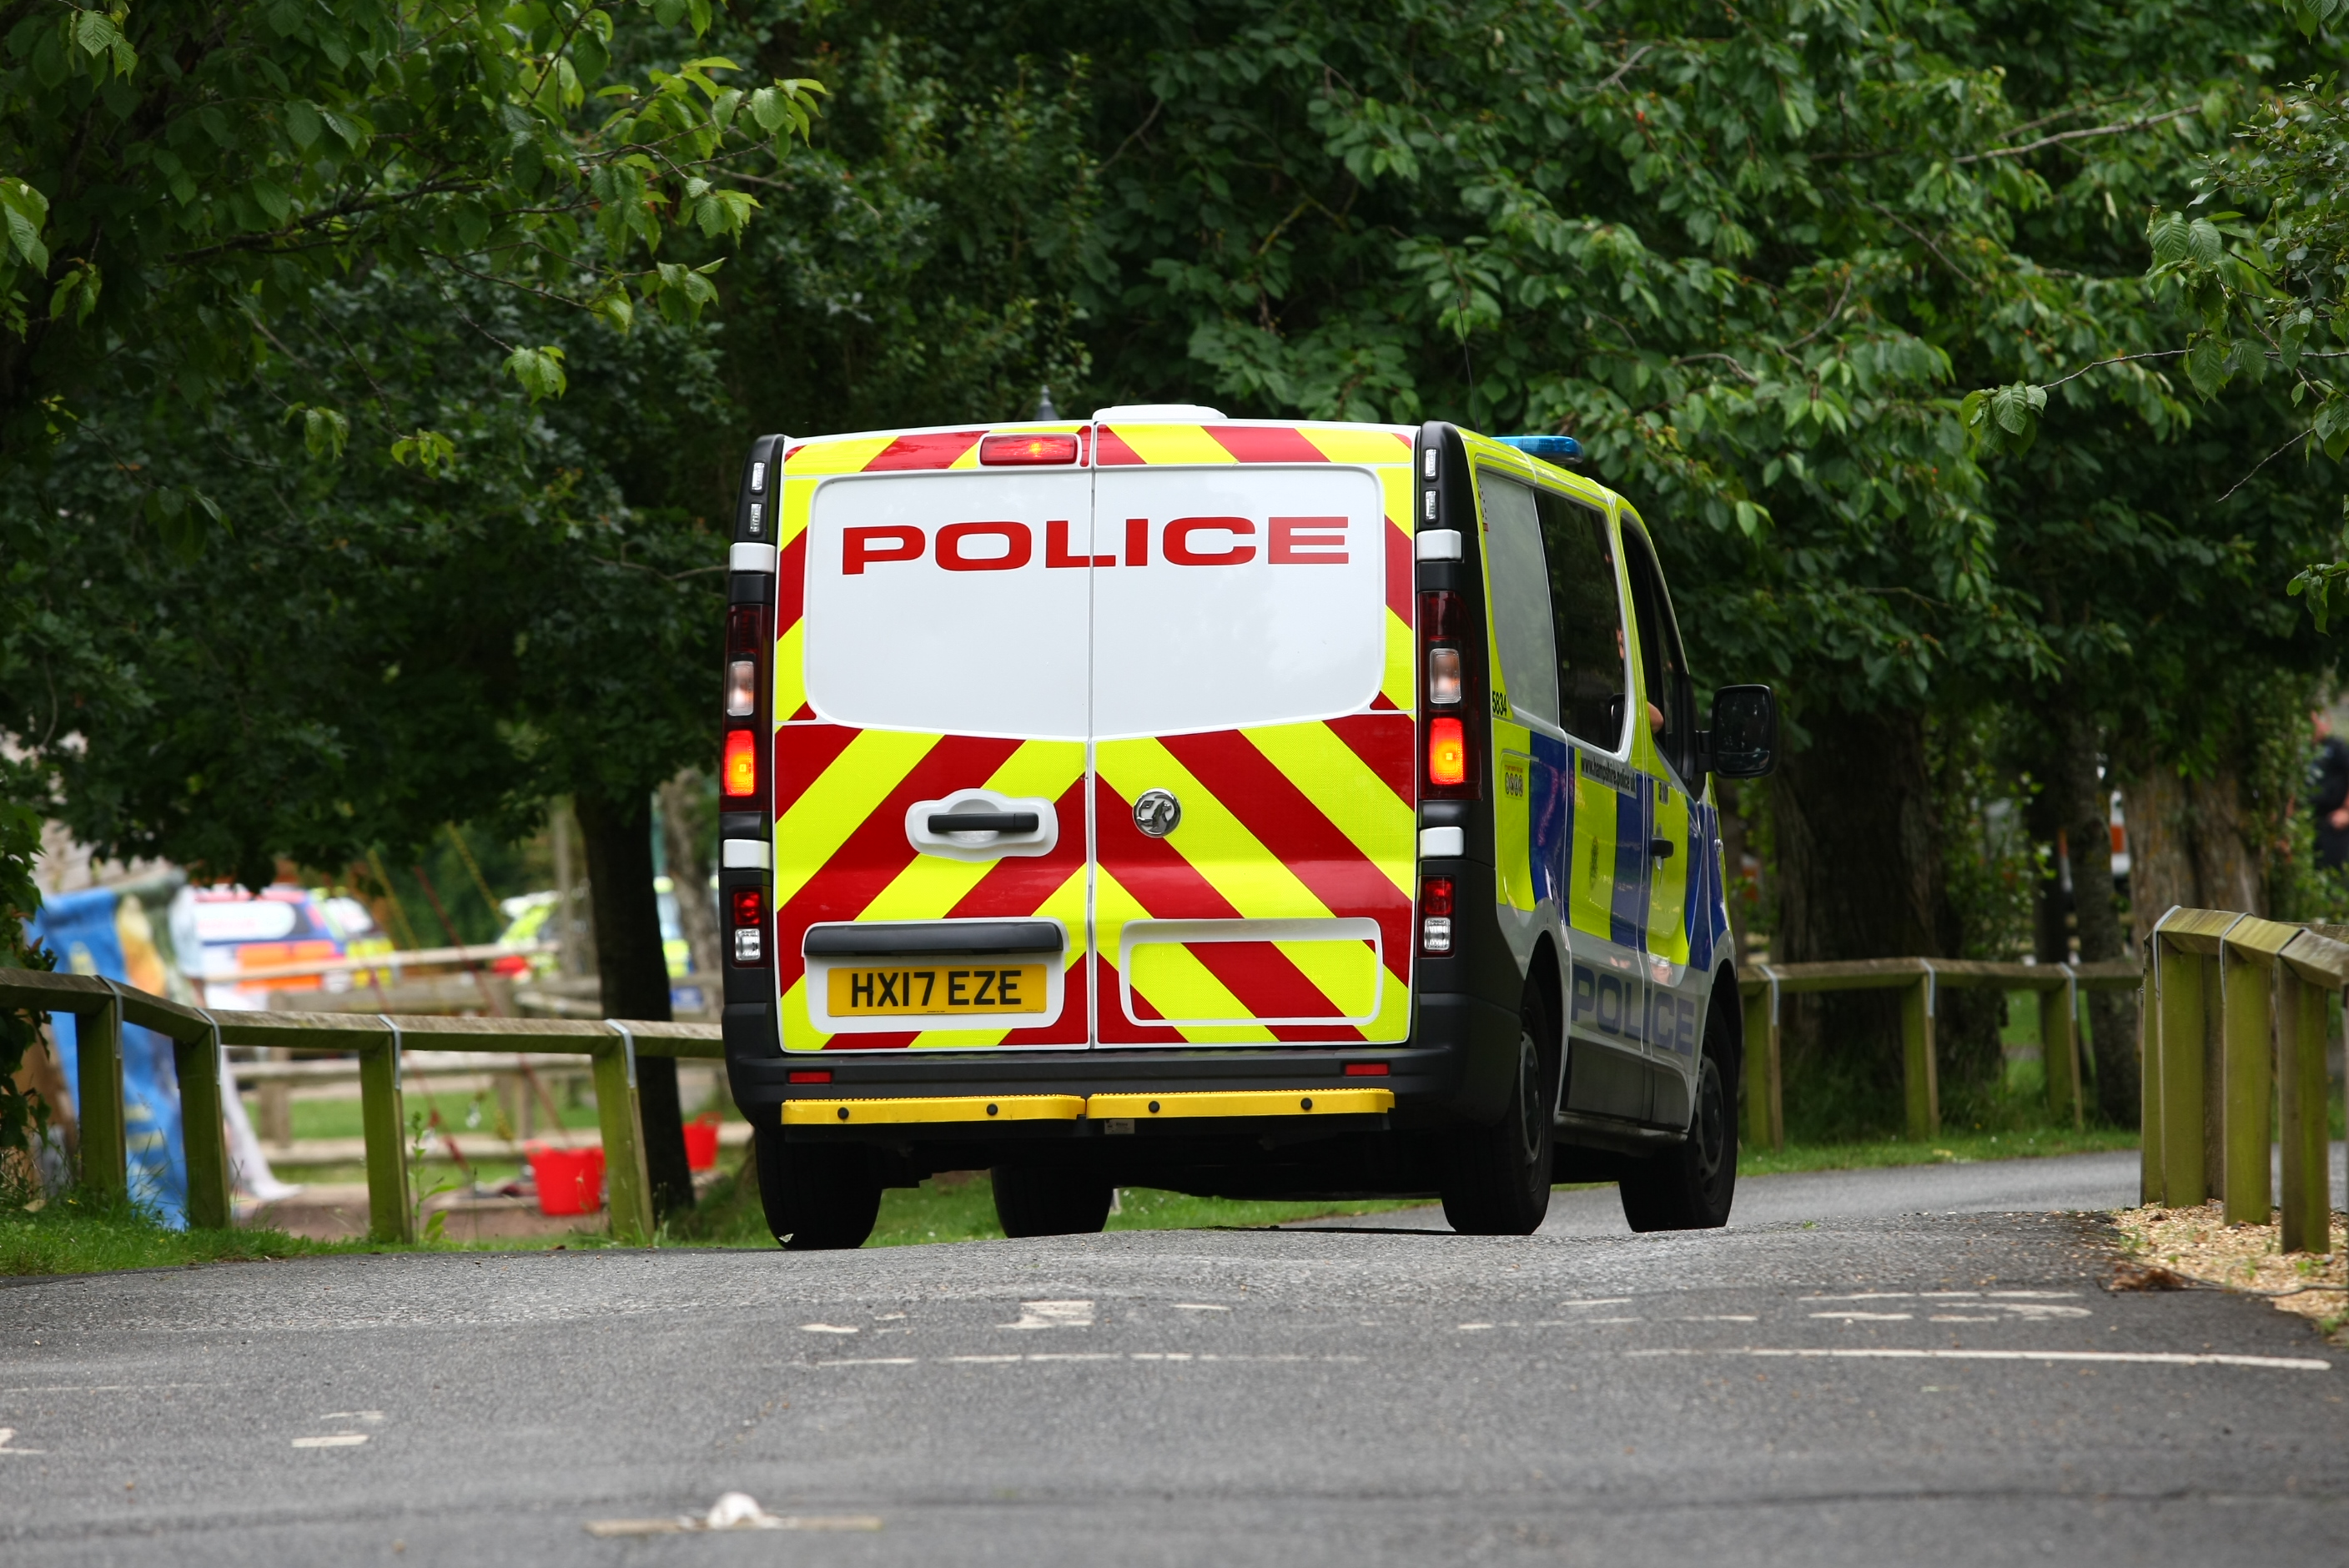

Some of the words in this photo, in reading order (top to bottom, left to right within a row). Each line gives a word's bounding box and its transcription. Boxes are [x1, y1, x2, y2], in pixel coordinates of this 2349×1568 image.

[843, 516, 1350, 575] POLICE
[1491, 690, 1507, 716] 5834
[851, 971, 936, 1008] HX17
[948, 969, 1022, 1006] EZE
[1571, 963, 1695, 1058] POLICE
